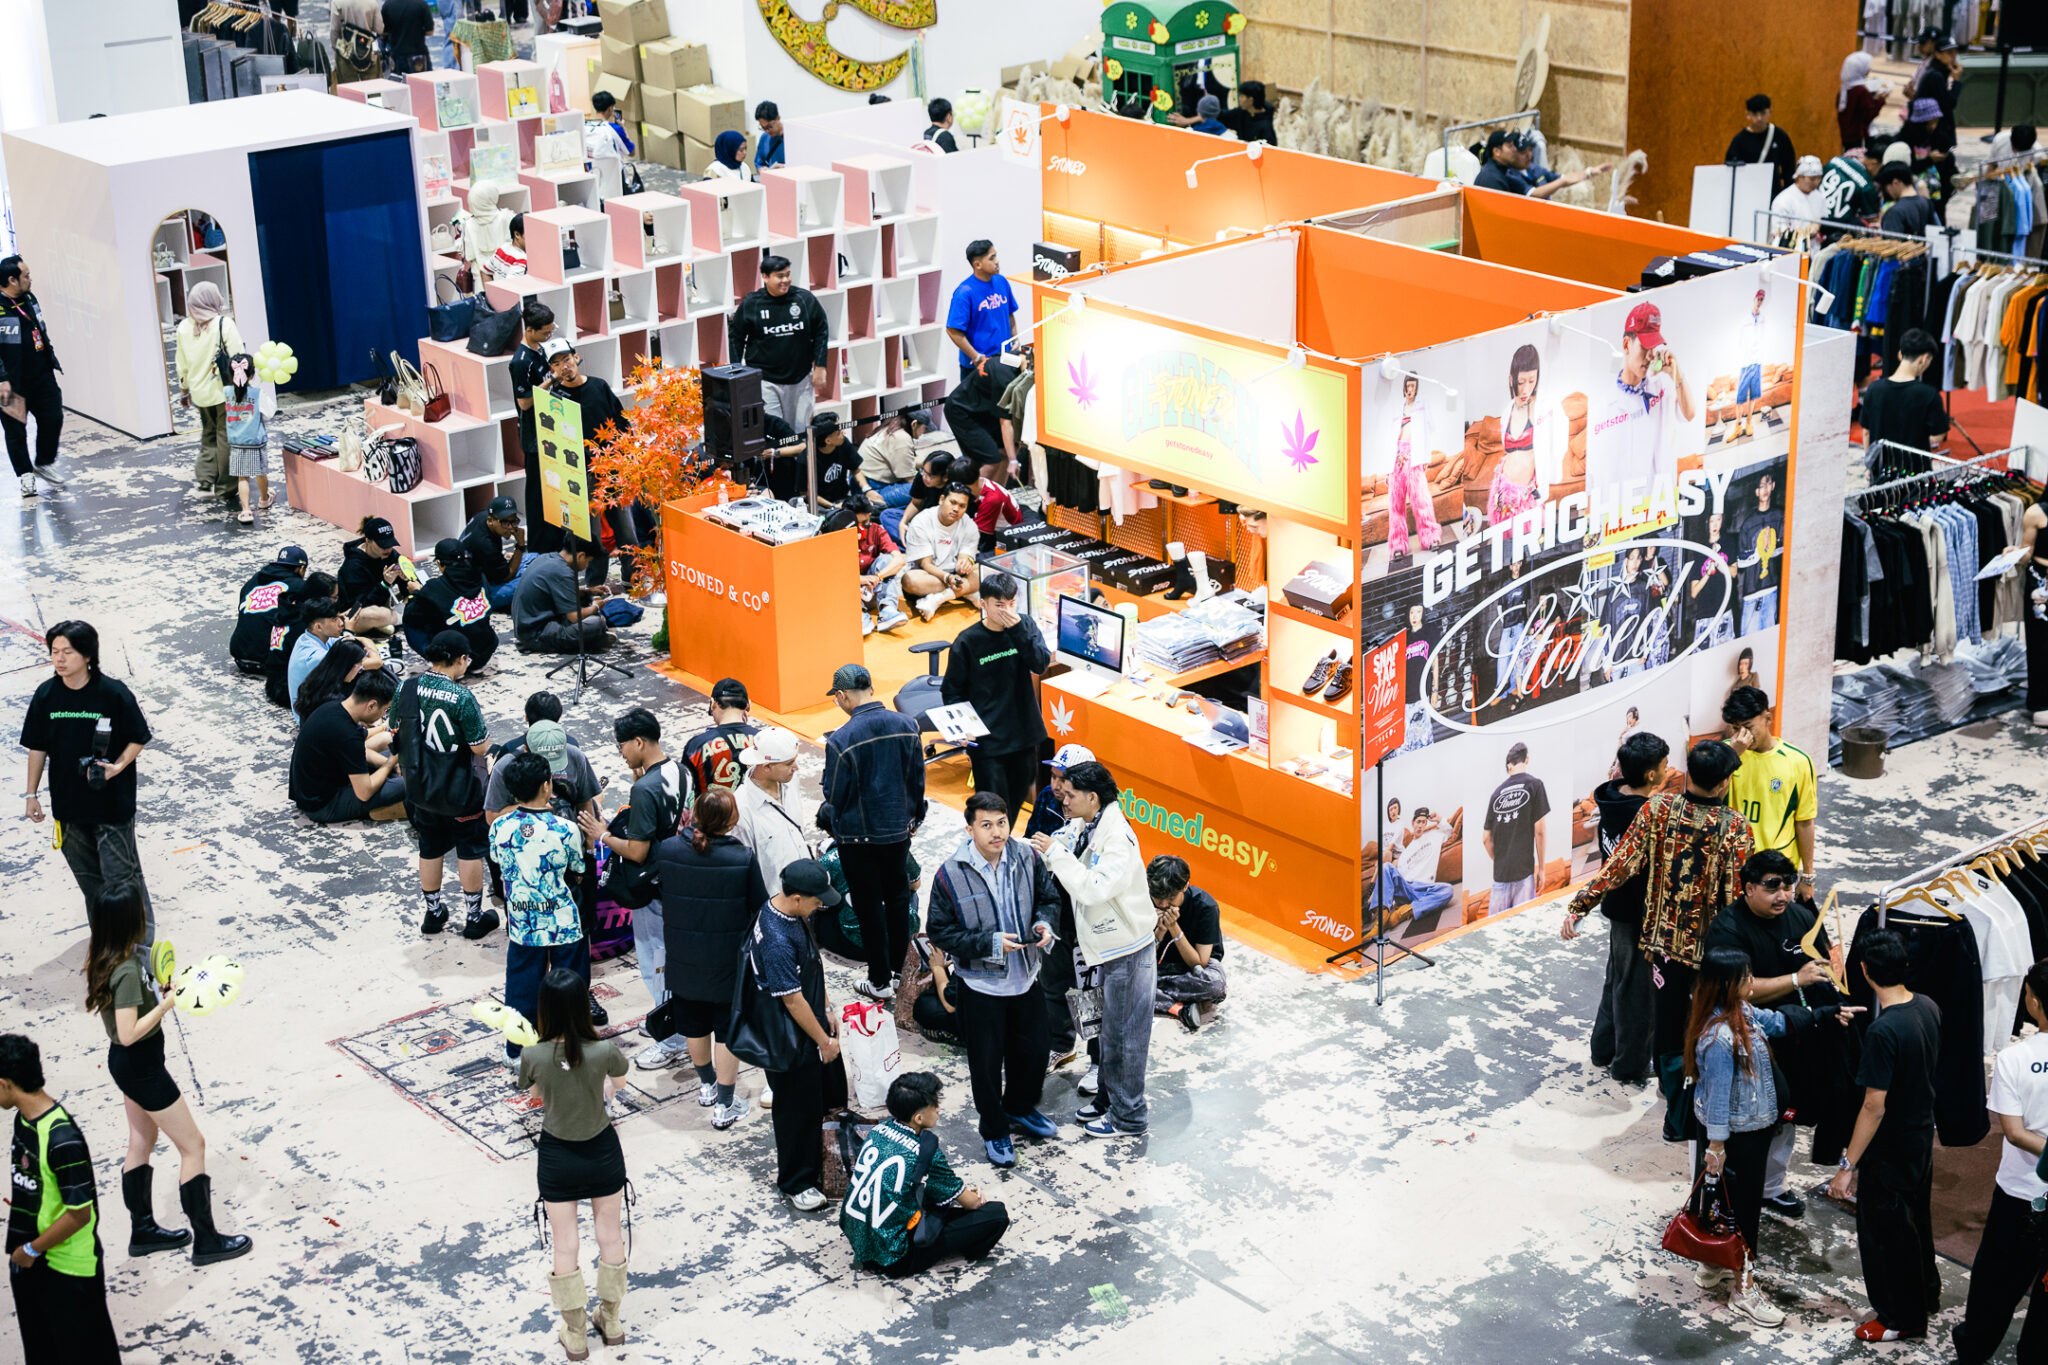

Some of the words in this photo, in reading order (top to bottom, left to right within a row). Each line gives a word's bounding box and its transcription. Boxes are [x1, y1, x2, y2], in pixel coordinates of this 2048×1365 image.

[1046, 155, 1087, 177] STONED
[760, 309, 770, 320] 11
[878, 409, 899, 421] STONED
[778, 434, 800, 446] STONED
[1422, 467, 1736, 611] GETRICHEASY
[670, 560, 724, 596] STONED
[728, 584, 738, 603] &
[1461, 560, 1696, 713] Stoned
[1373, 641, 1399, 674] SNAP
[1300, 909, 1355, 943] STONED
